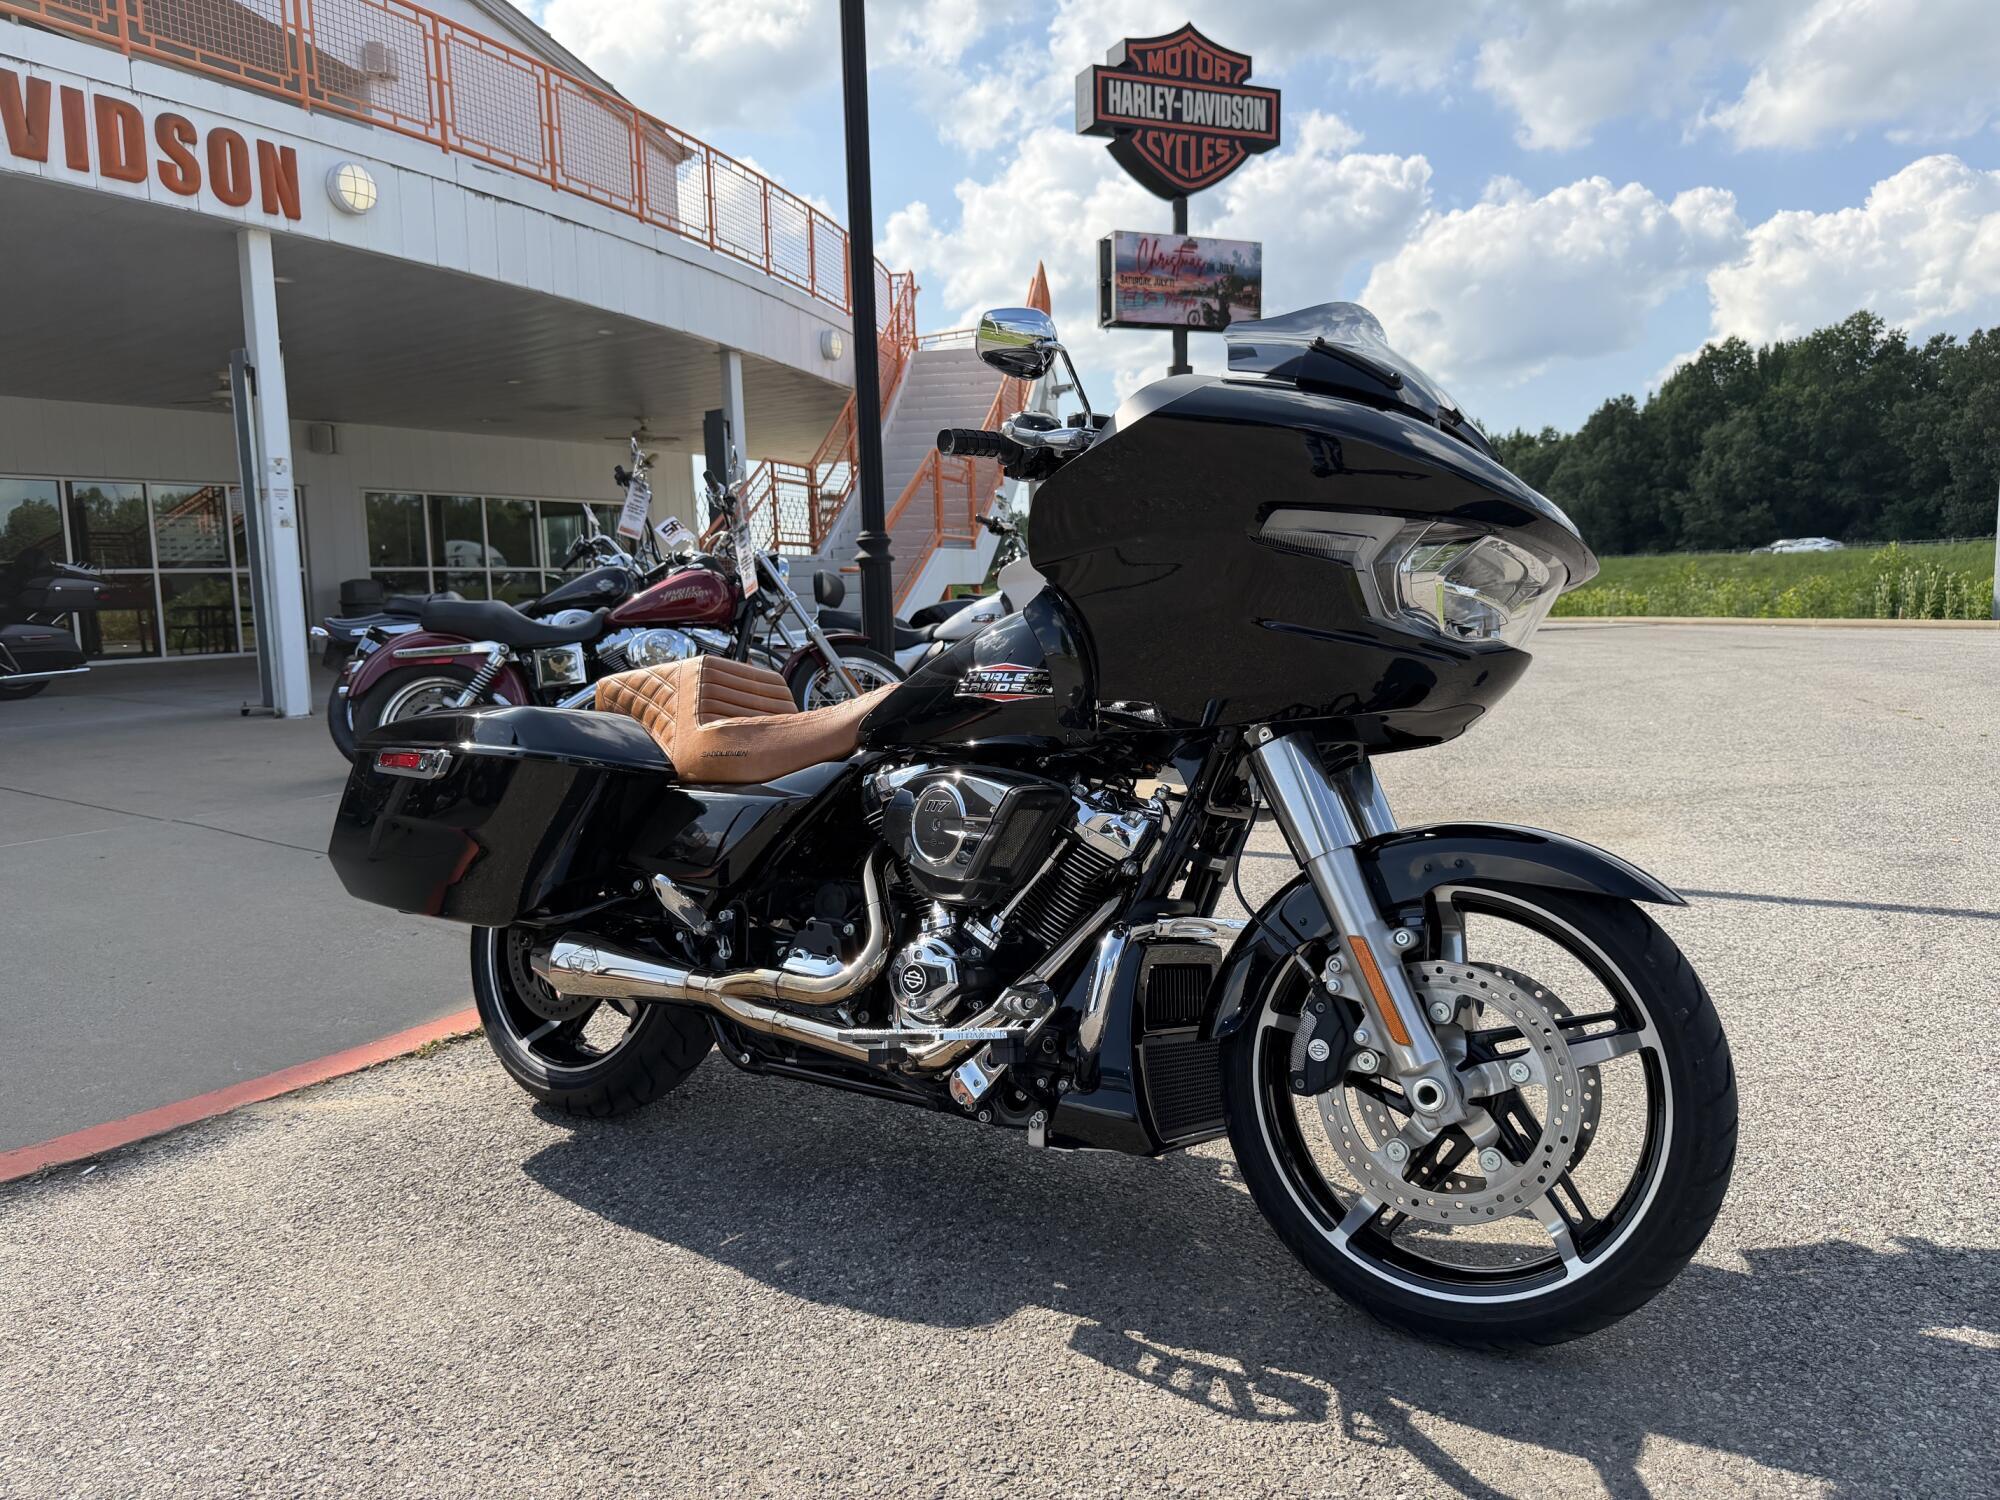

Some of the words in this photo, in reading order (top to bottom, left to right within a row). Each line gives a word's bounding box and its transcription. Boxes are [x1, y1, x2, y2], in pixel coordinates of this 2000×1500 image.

[1147, 40, 1231, 83] MOTOR
[1108, 80, 1267, 131] HARLEY-DAVIDSON
[1147, 130, 1230, 178] CYCLES
[925, 800, 952, 812] 117
